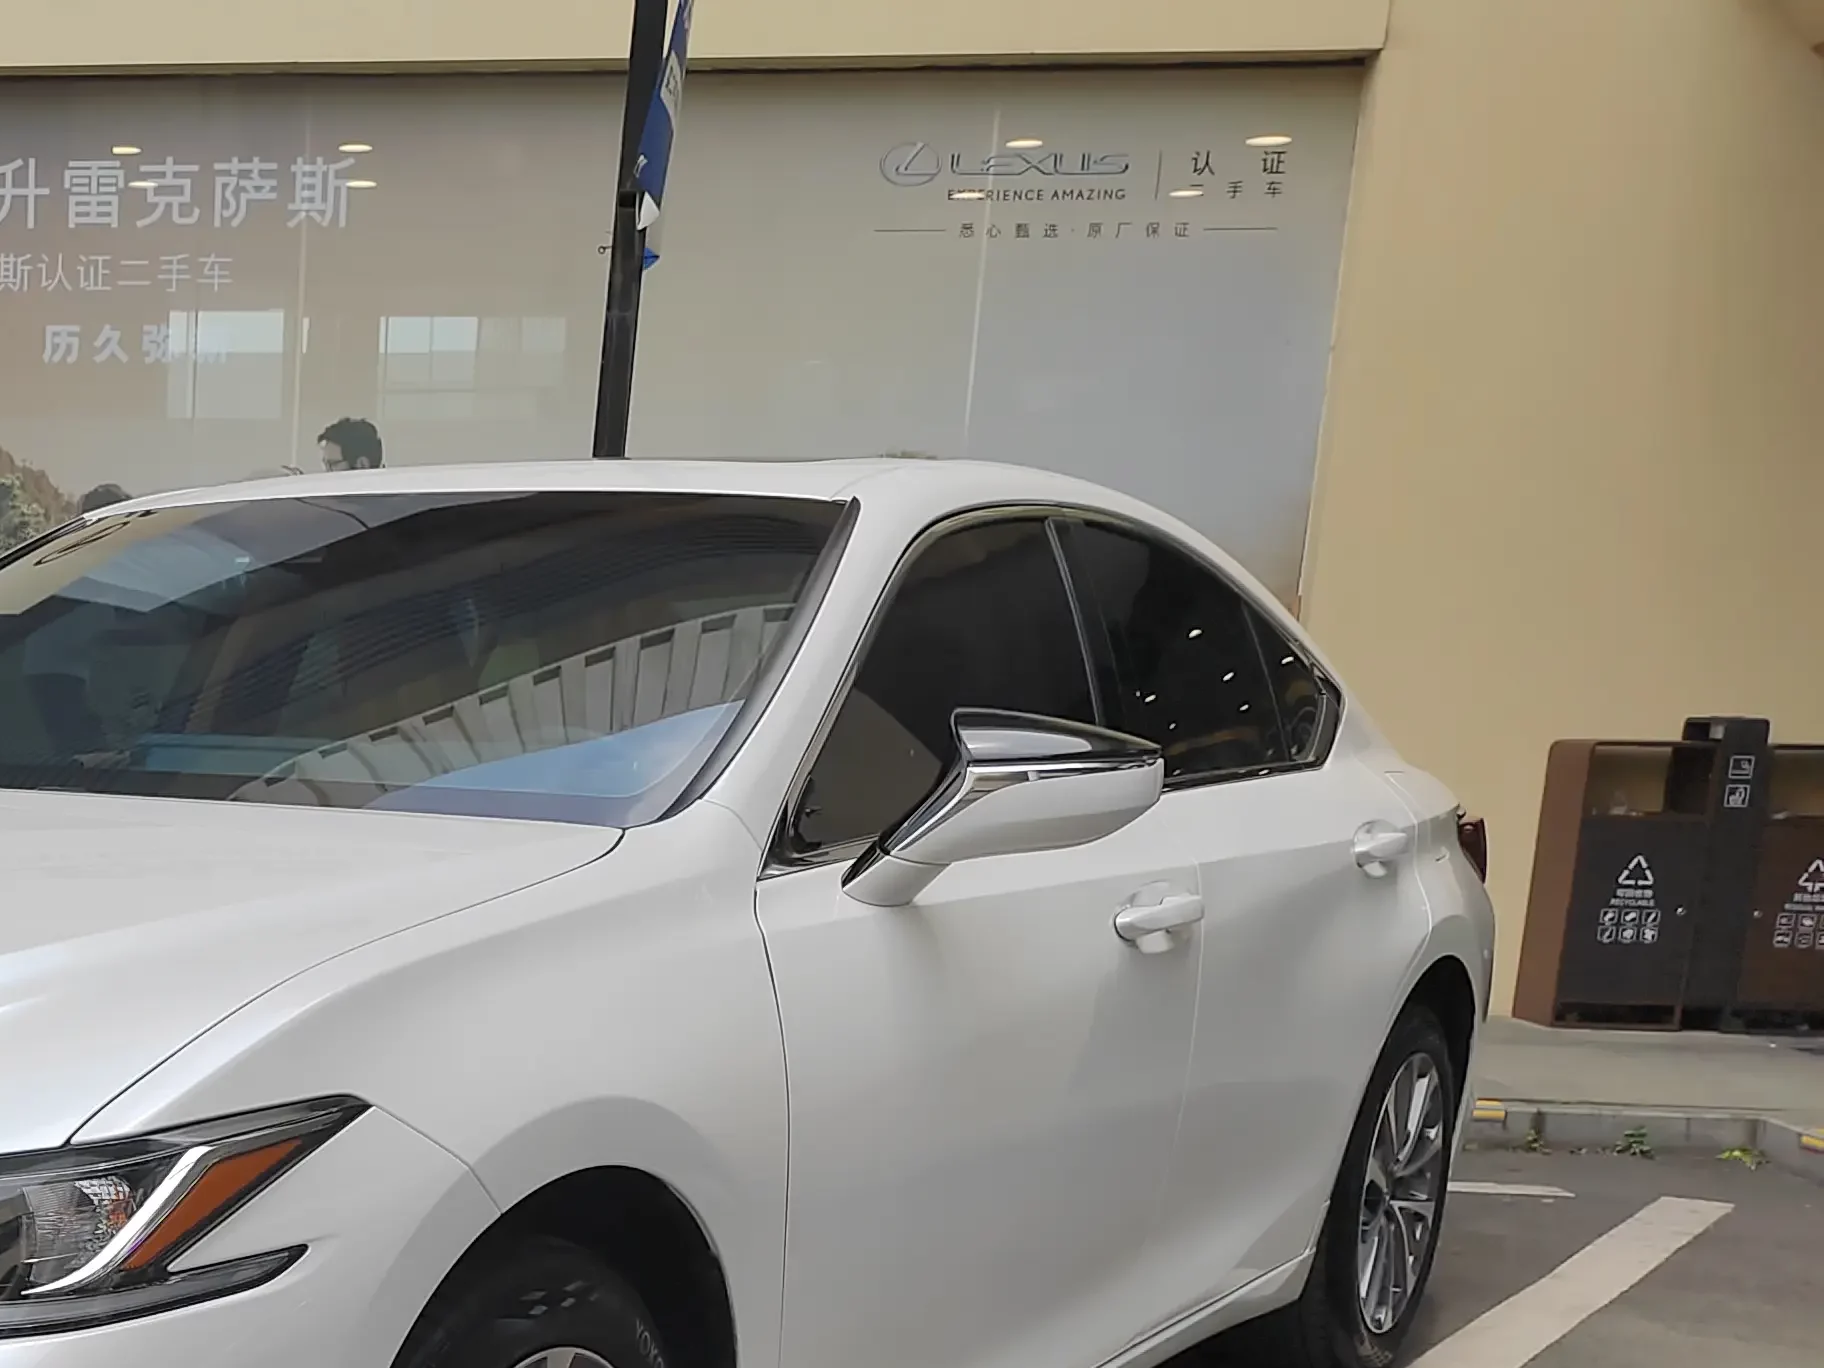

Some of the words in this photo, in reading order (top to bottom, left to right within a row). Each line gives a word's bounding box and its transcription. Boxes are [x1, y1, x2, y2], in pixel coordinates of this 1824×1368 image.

[949, 152, 1130, 176] LEXUS
[1192, 150, 1287, 175] 认证
[1050, 188, 1126, 201] AMAZING
[42, 323, 226, 364] 历久弥
